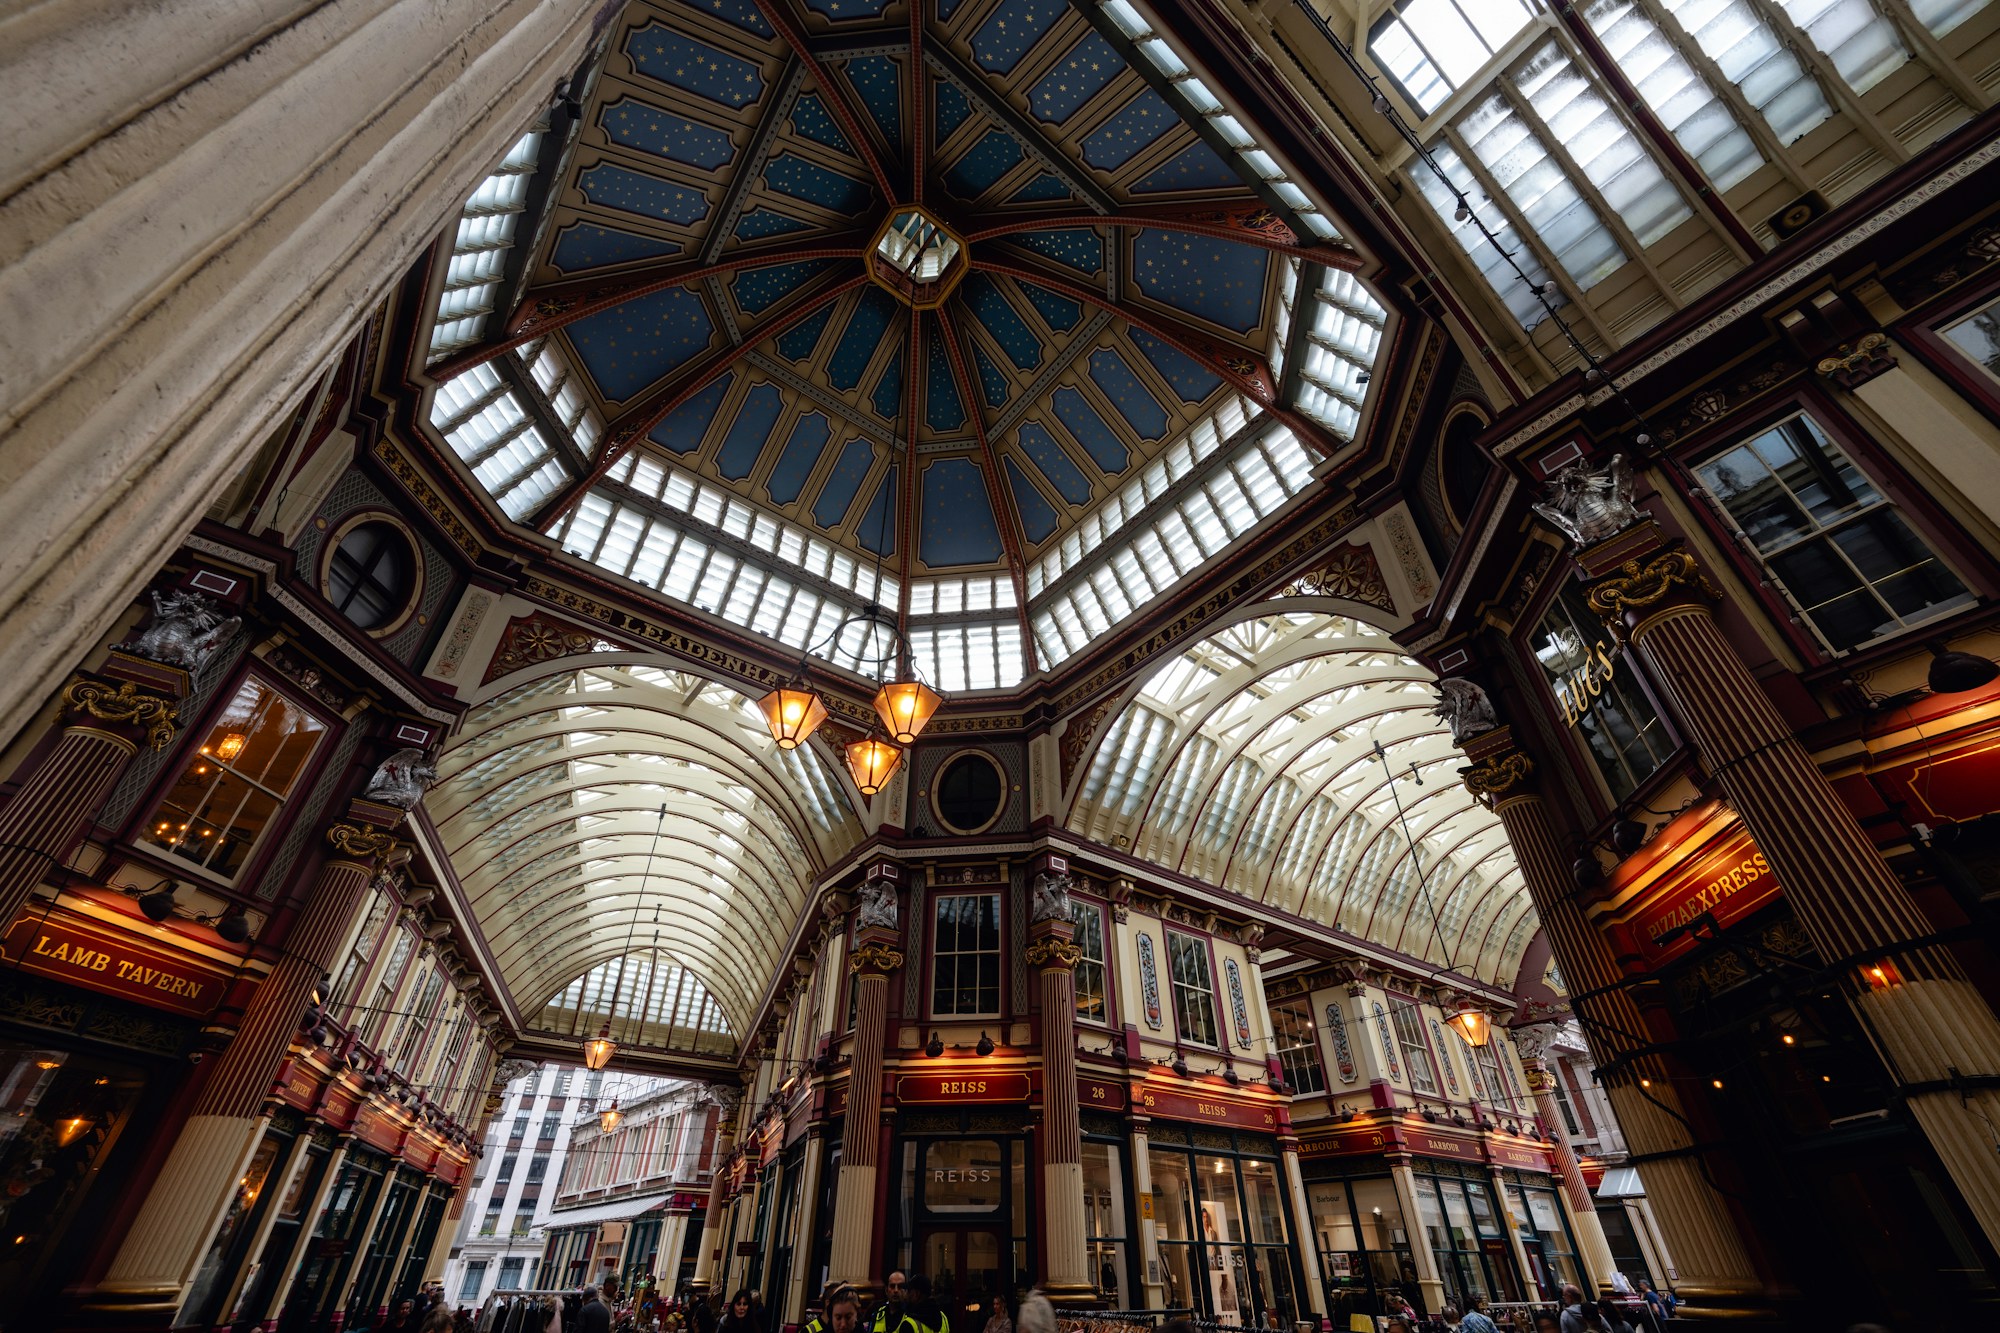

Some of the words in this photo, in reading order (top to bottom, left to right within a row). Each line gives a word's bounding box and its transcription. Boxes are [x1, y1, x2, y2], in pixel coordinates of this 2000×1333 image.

[1647, 852, 1771, 940] PIZZAEXPRESS
[33, 936, 111, 972] LAMB
[116, 960, 204, 999] TAVERN
[941, 1081, 987, 1094] REISS
[1092, 1086, 1105, 1099] 26
[1144, 1095, 1155, 1107] 26
[1199, 1103, 1227, 1117] REISS
[1264, 1113, 1274, 1124] 26
[1297, 1140, 1341, 1154] ARBOUR
[1372, 1136, 1383, 1146] 31
[1428, 1140, 1461, 1153] BARBOUR
[934, 1169, 991, 1182] REISS
[1316, 1195, 1340, 1203] Barbour
[1209, 1254, 1244, 1268] REISS
